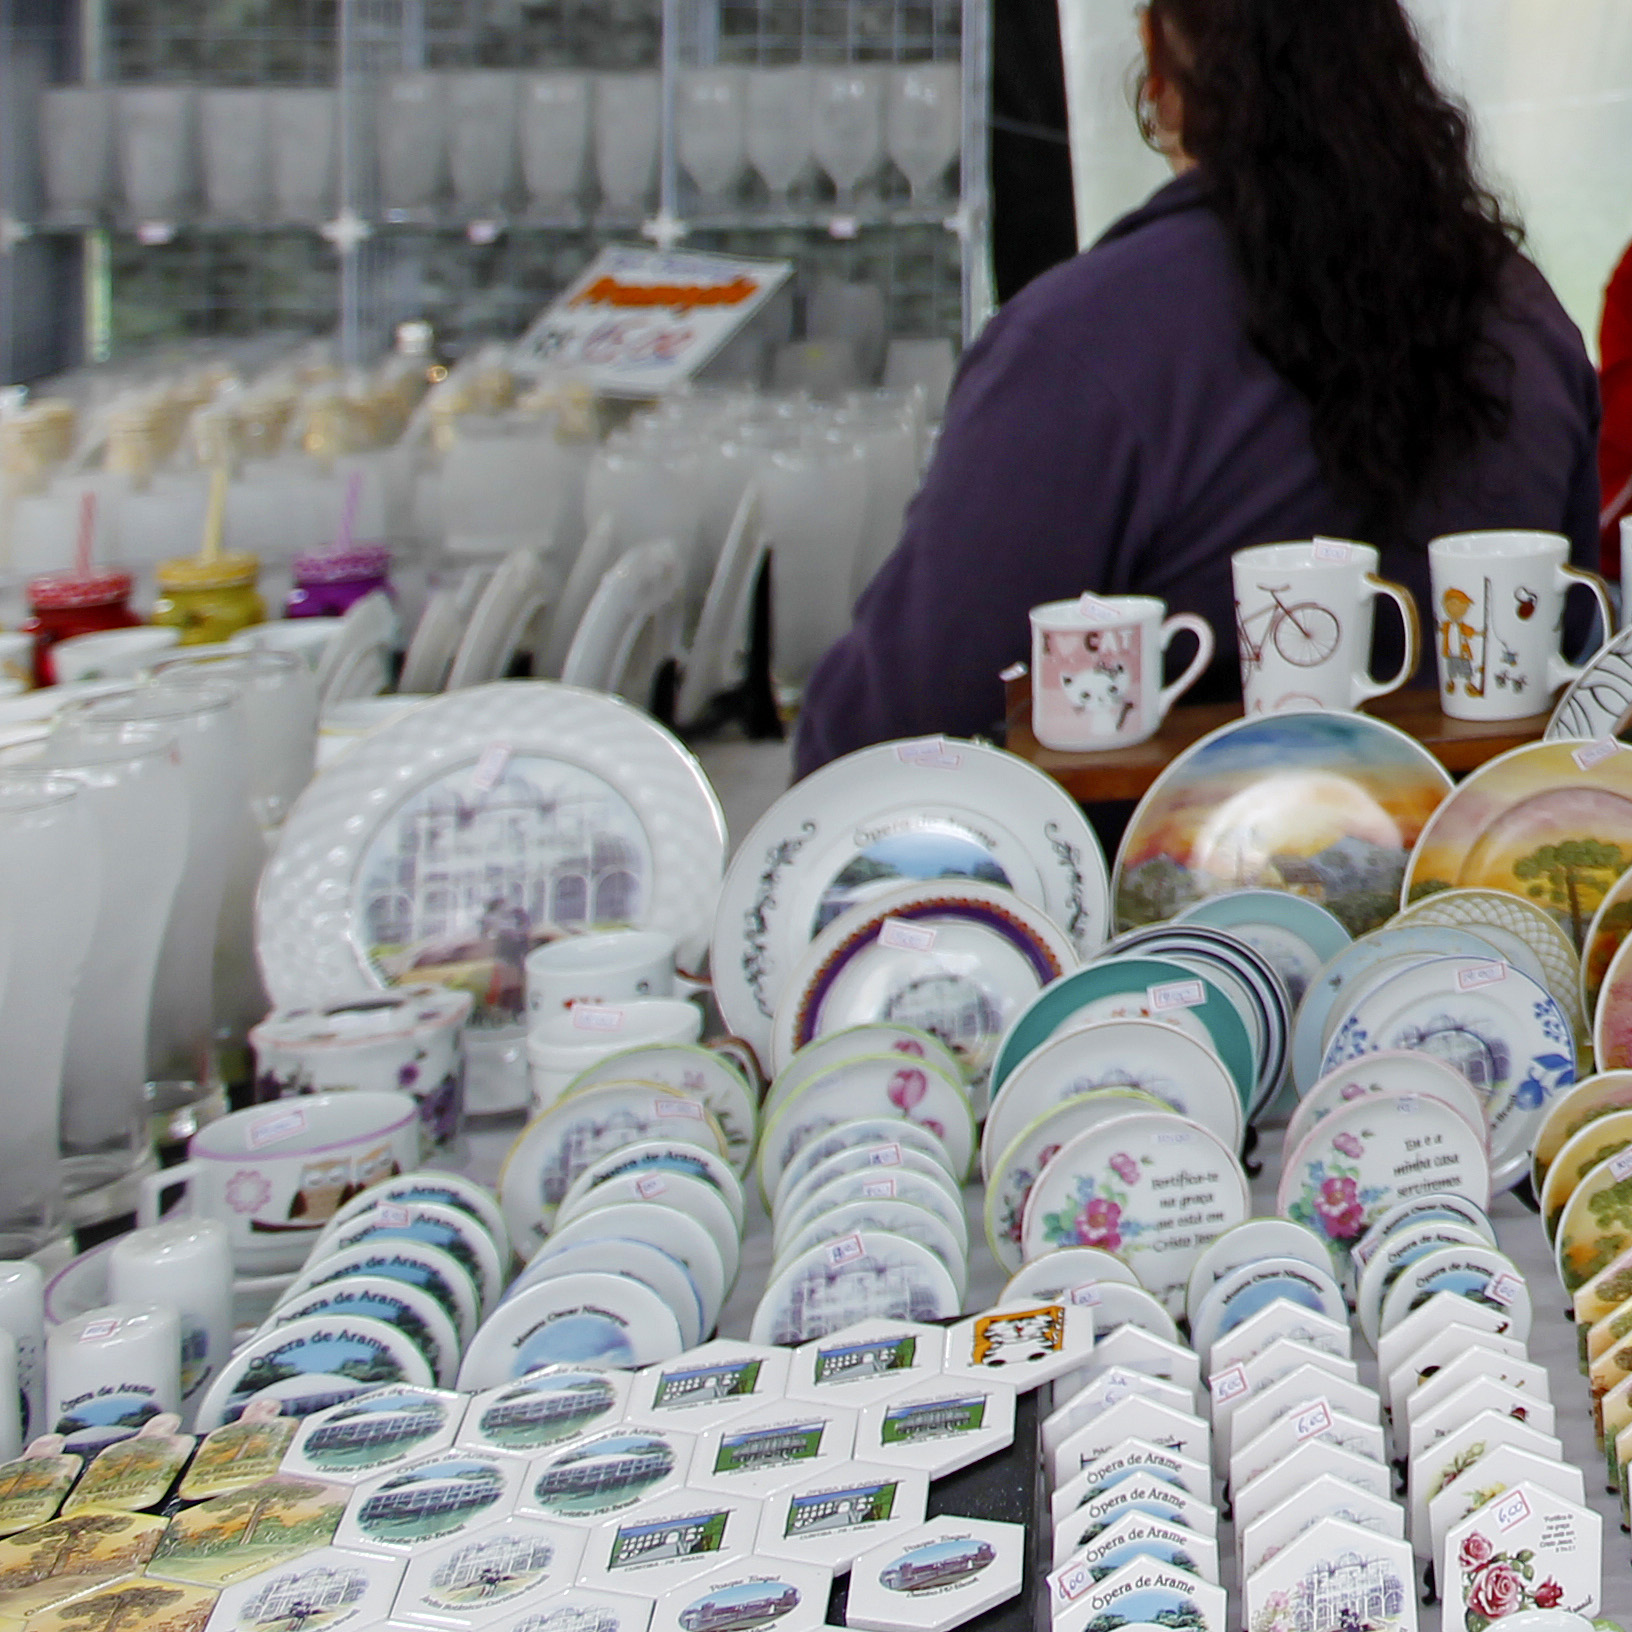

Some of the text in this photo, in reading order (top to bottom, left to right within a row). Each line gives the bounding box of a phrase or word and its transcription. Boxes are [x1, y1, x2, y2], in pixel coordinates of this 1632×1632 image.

[1126, 1452, 1142, 1466] de
[1144, 1452, 1183, 1473] Arame
[1129, 1487, 1146, 1501] de
[1148, 1486, 1188, 1511] Arame
[1128, 1527, 1145, 1541] de
[1146, 1526, 1188, 1547] Arame
[1134, 1575, 1152, 1589] de
[1153, 1574, 1196, 1596] Arame
